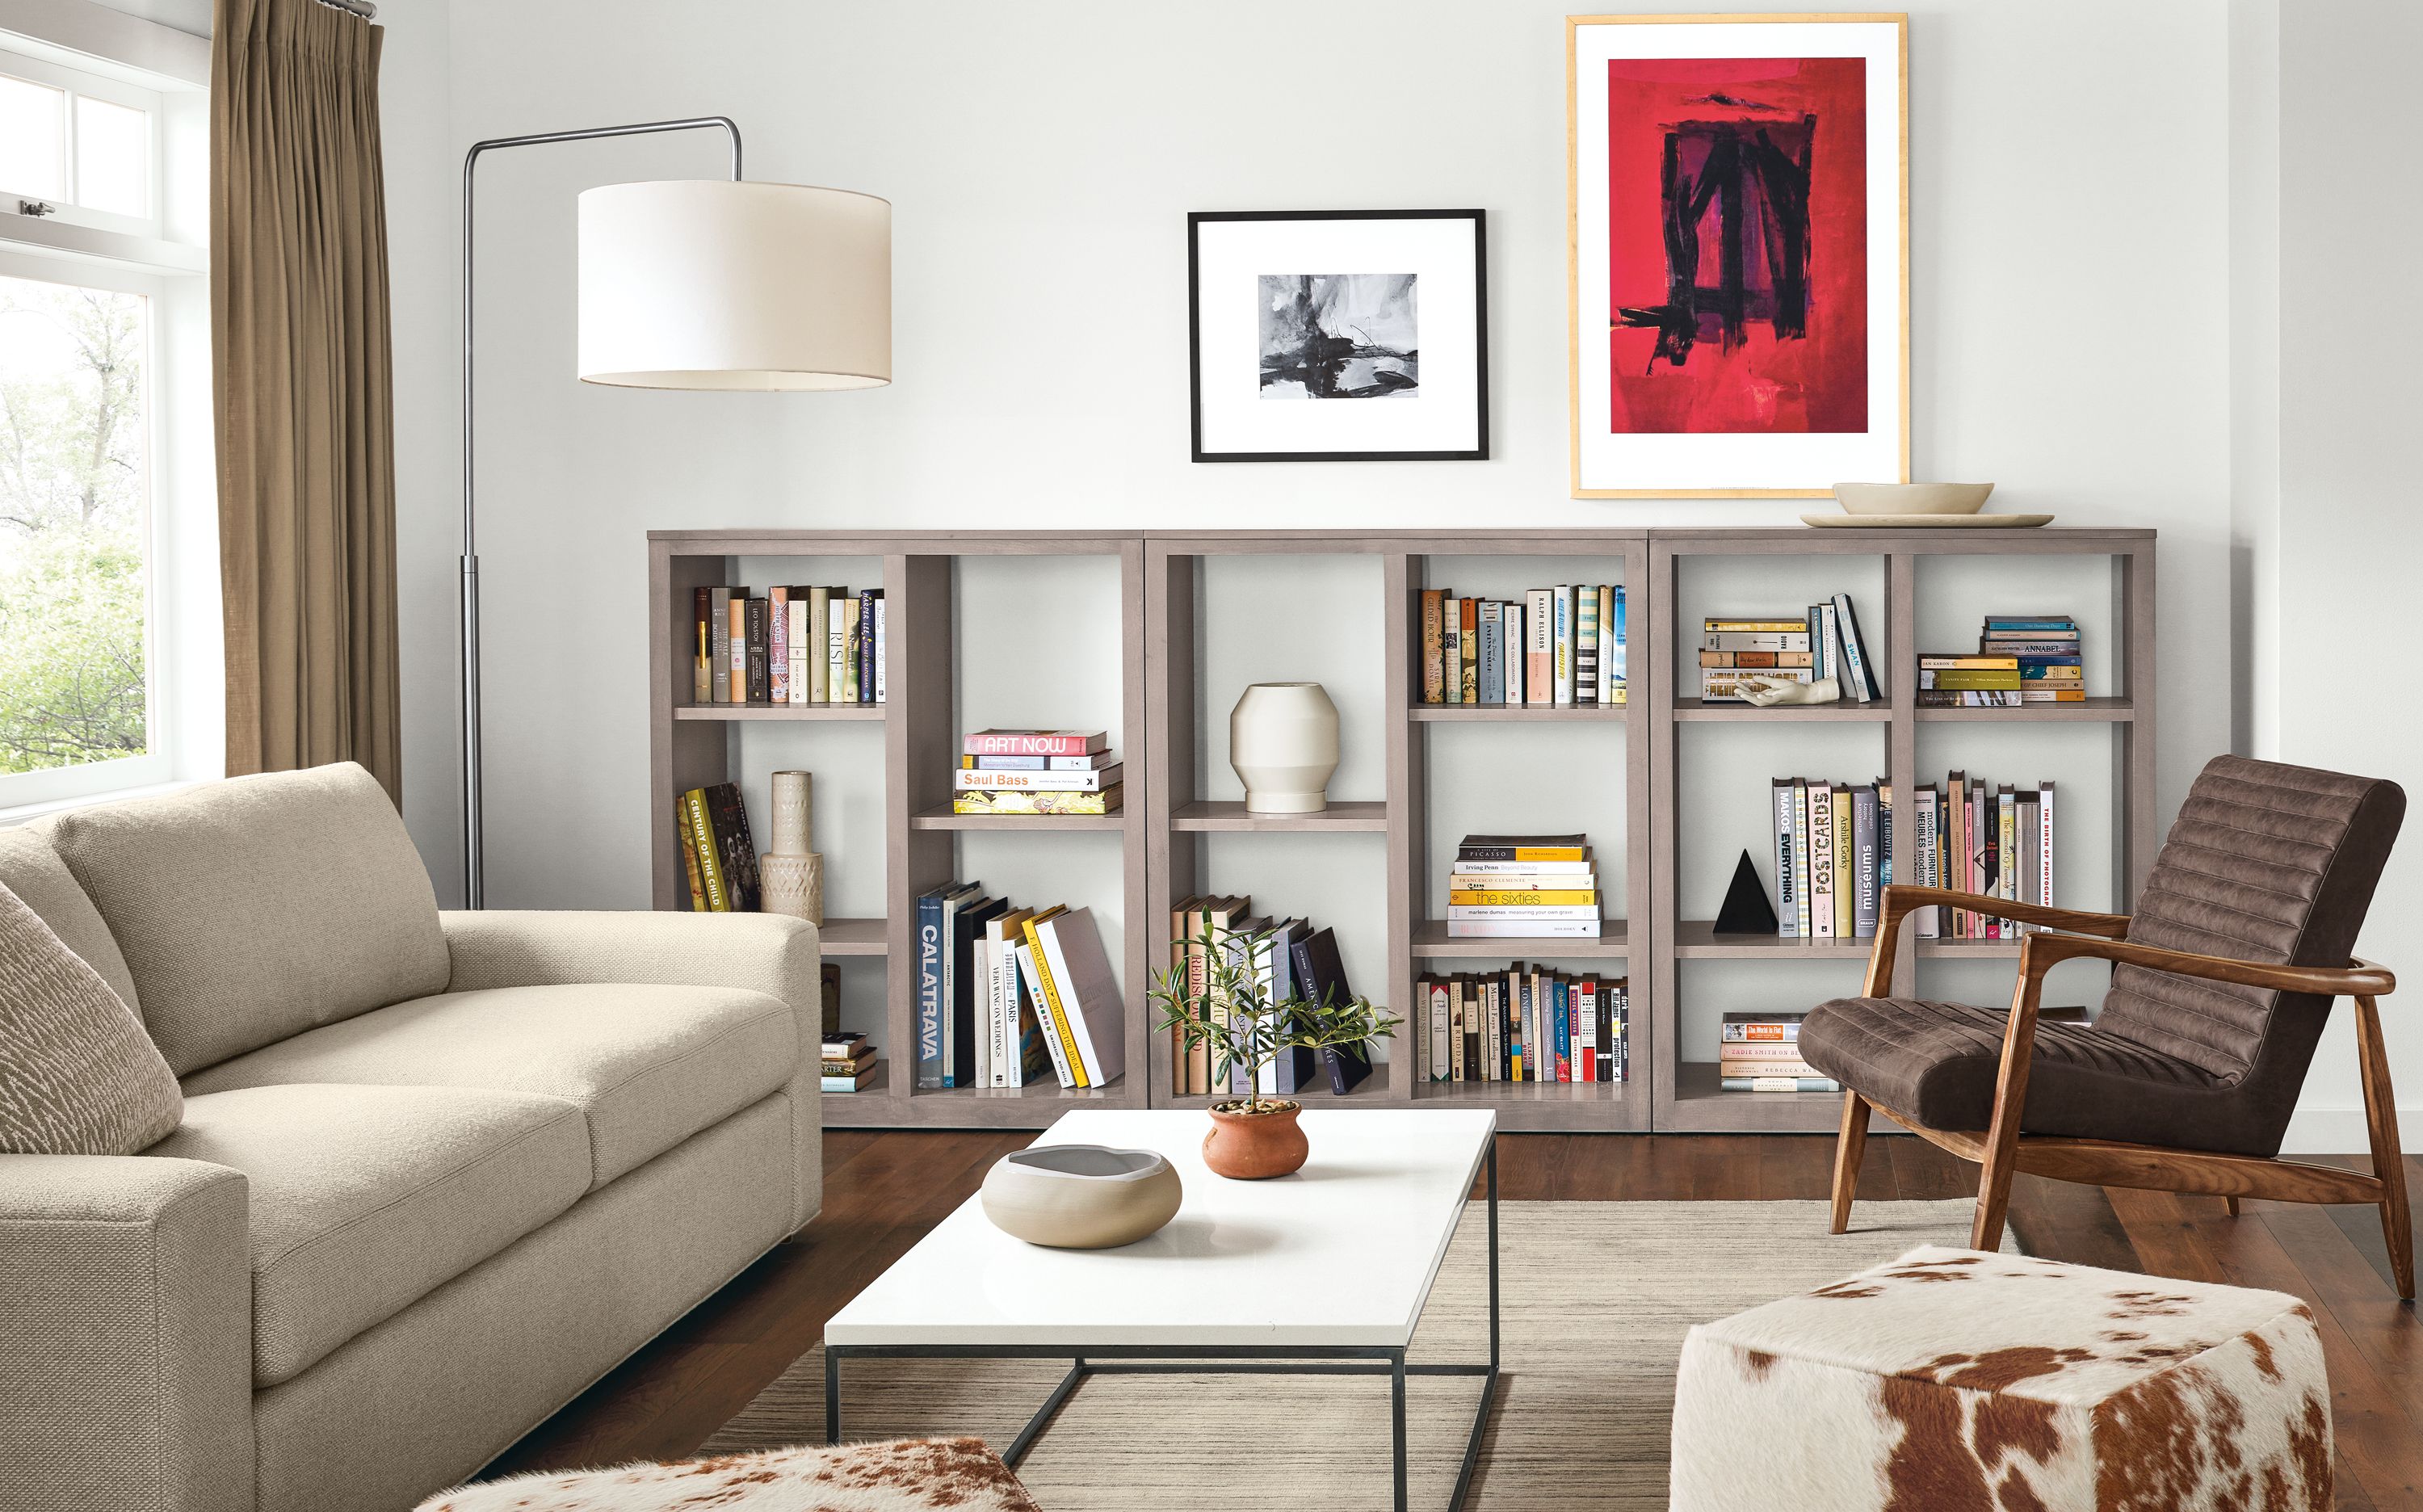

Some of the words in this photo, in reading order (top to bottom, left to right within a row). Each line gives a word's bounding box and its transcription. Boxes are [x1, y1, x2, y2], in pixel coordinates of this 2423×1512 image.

[863, 593, 871, 620] HARPER
[1427, 597, 1435, 622] GILDED
[1557, 597, 1565, 612] ALICE
[1427, 624, 1435, 643] HOUR
[829, 632, 843, 672] RISE
[1557, 642, 1565, 666] CHARLES
[1847, 643, 1860, 666] SWAN
[846, 662, 855, 677] Light
[985, 737, 1018, 753] ART
[1023, 737, 1066, 753] NOW
[964, 774, 992, 785] Saul
[997, 775, 1028, 785] Bass
[691, 800, 706, 842] CENTURY
[1779, 792, 1791, 834] MAKOS
[1840, 816, 1849, 843] Arshile
[1884, 818, 1892, 856] LEIBOVITZ
[1917, 811, 1925, 848] MEUBLES
[1927, 811, 1935, 846] modern
[701, 842, 710, 856] OF
[1813, 792, 1832, 895] POSTCARDS
[2044, 849, 2050, 859] OF
[703, 858, 714, 877] THE
[1781, 834, 1792, 904] EVERYTHING
[1839, 845, 1850, 870] Gorky
[2002, 856, 2009, 864] Cy
[1862, 844, 1872, 910] museums
[2002, 865, 2010, 889] Twombly
[708, 879, 720, 905] CHILD
[1476, 892, 1497, 905] the
[1501, 892, 1541, 905] sixties
[1005, 953, 1015, 990] SURREALISM
[1031, 943, 1048, 976] HOLLAND
[922, 924, 938, 1060] CALATRAVA
[1043, 977, 1052, 992] DAY
[994, 1007, 1001, 1018] ON
[1008, 999, 1017, 1023] PARIS
[1051, 998, 1067, 1035] SUFFERING
[1756, 1026, 1768, 1034] World
[1768, 1026, 1774, 1034] Is
[1773, 1026, 1782, 1034] Flat
[1049, 1034, 1060, 1057] INTERVIEWS
[1062, 1035, 1072, 1050] THE
[1066, 1050, 1080, 1071] IDEAL
